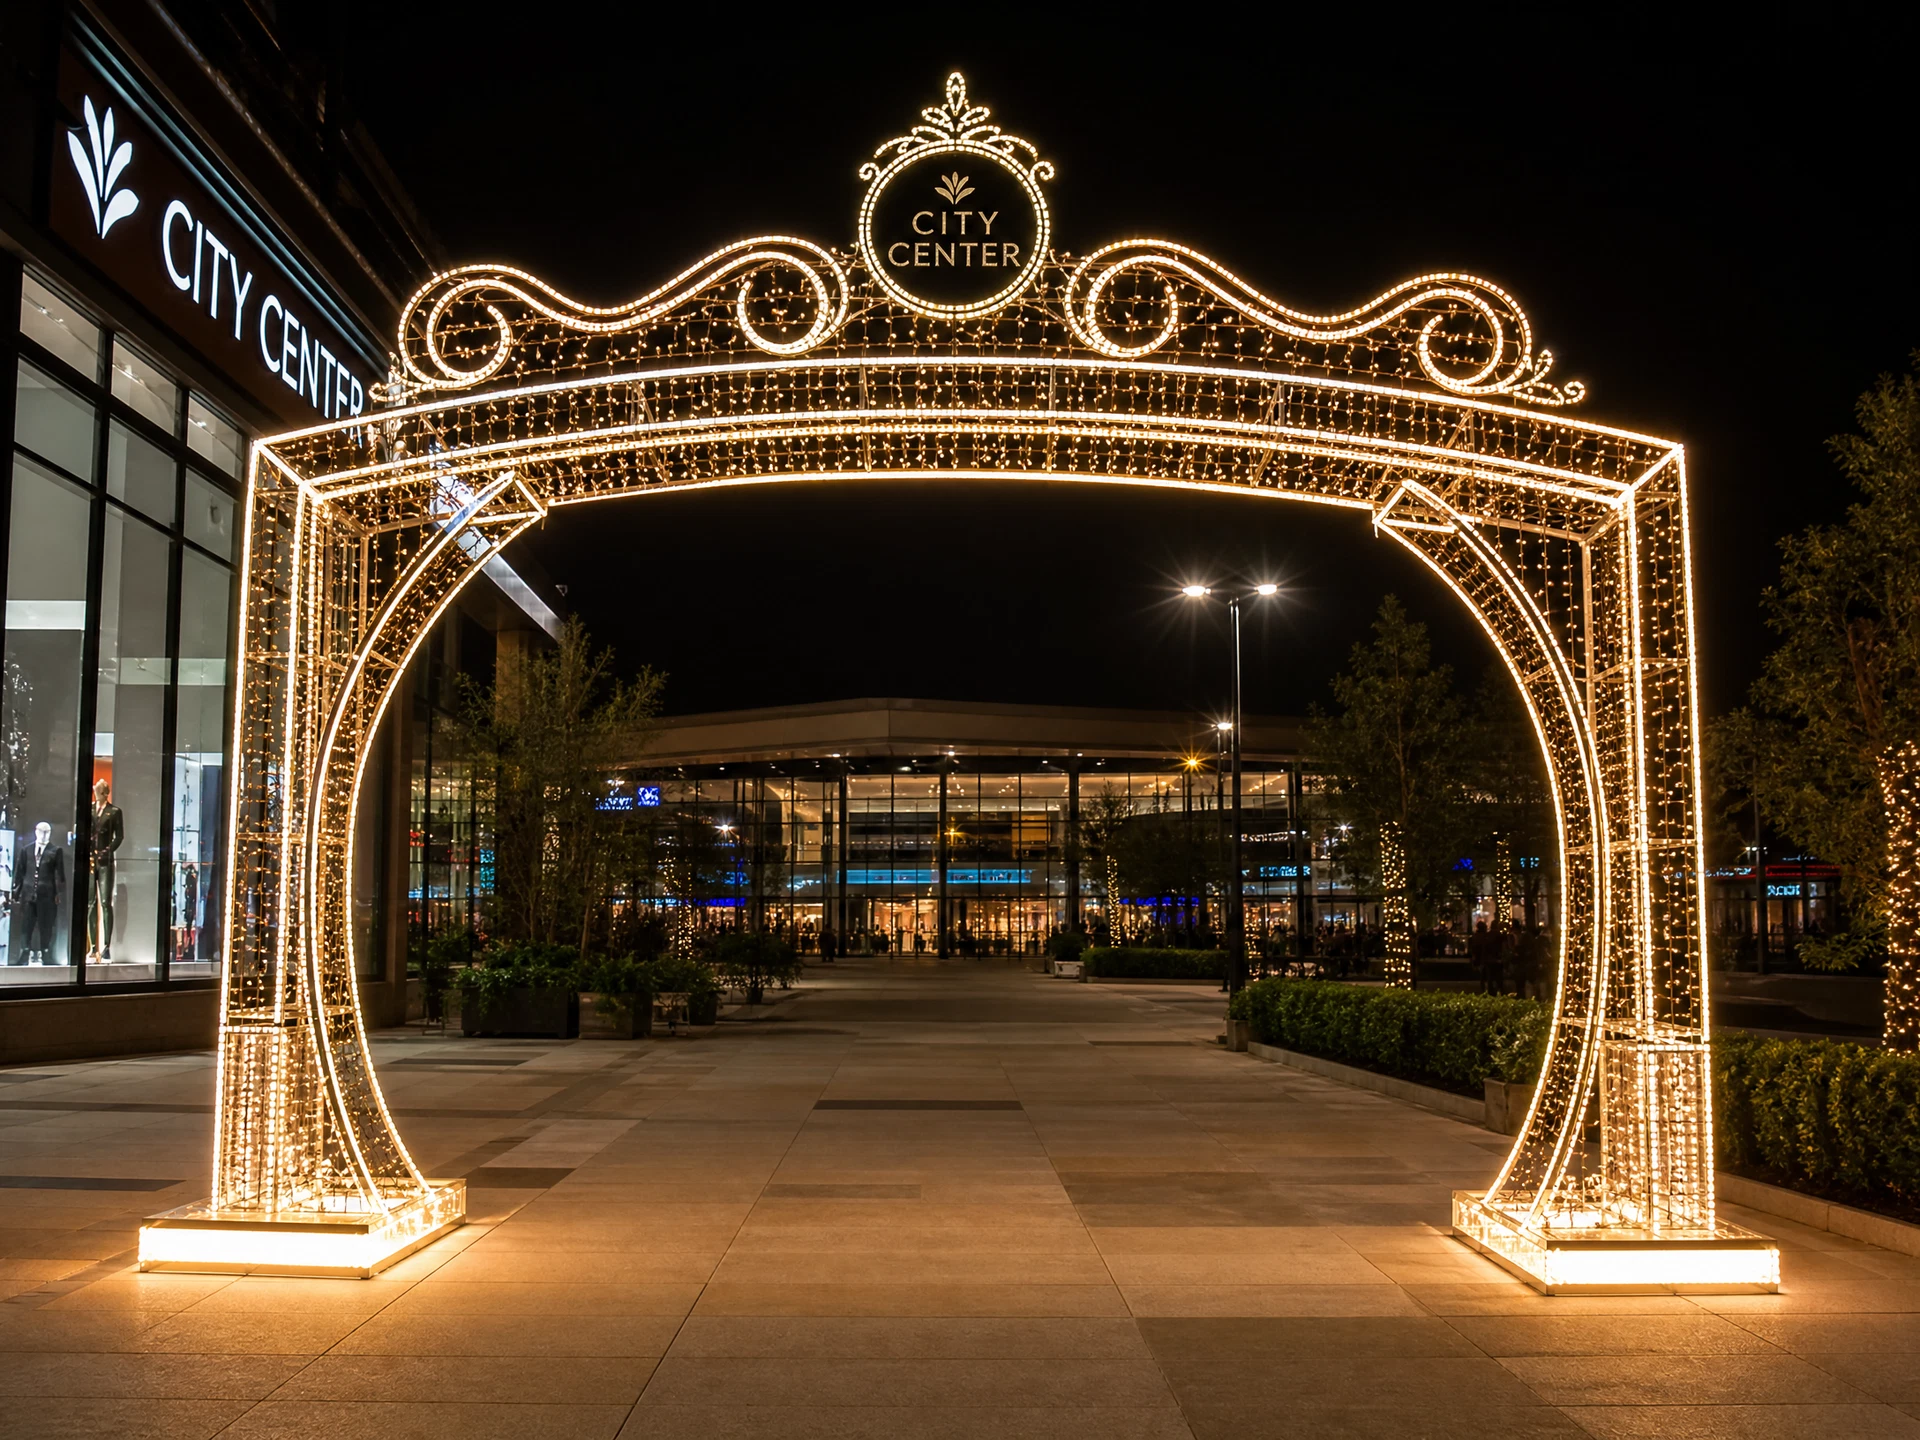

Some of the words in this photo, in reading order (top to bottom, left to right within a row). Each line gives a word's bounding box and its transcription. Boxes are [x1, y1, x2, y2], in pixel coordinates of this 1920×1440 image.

[912, 211, 998, 235] CITY
[888, 242, 1021, 267] CENTER
[162, 200, 253, 341] CITY
[260, 295, 363, 448] CENTER
